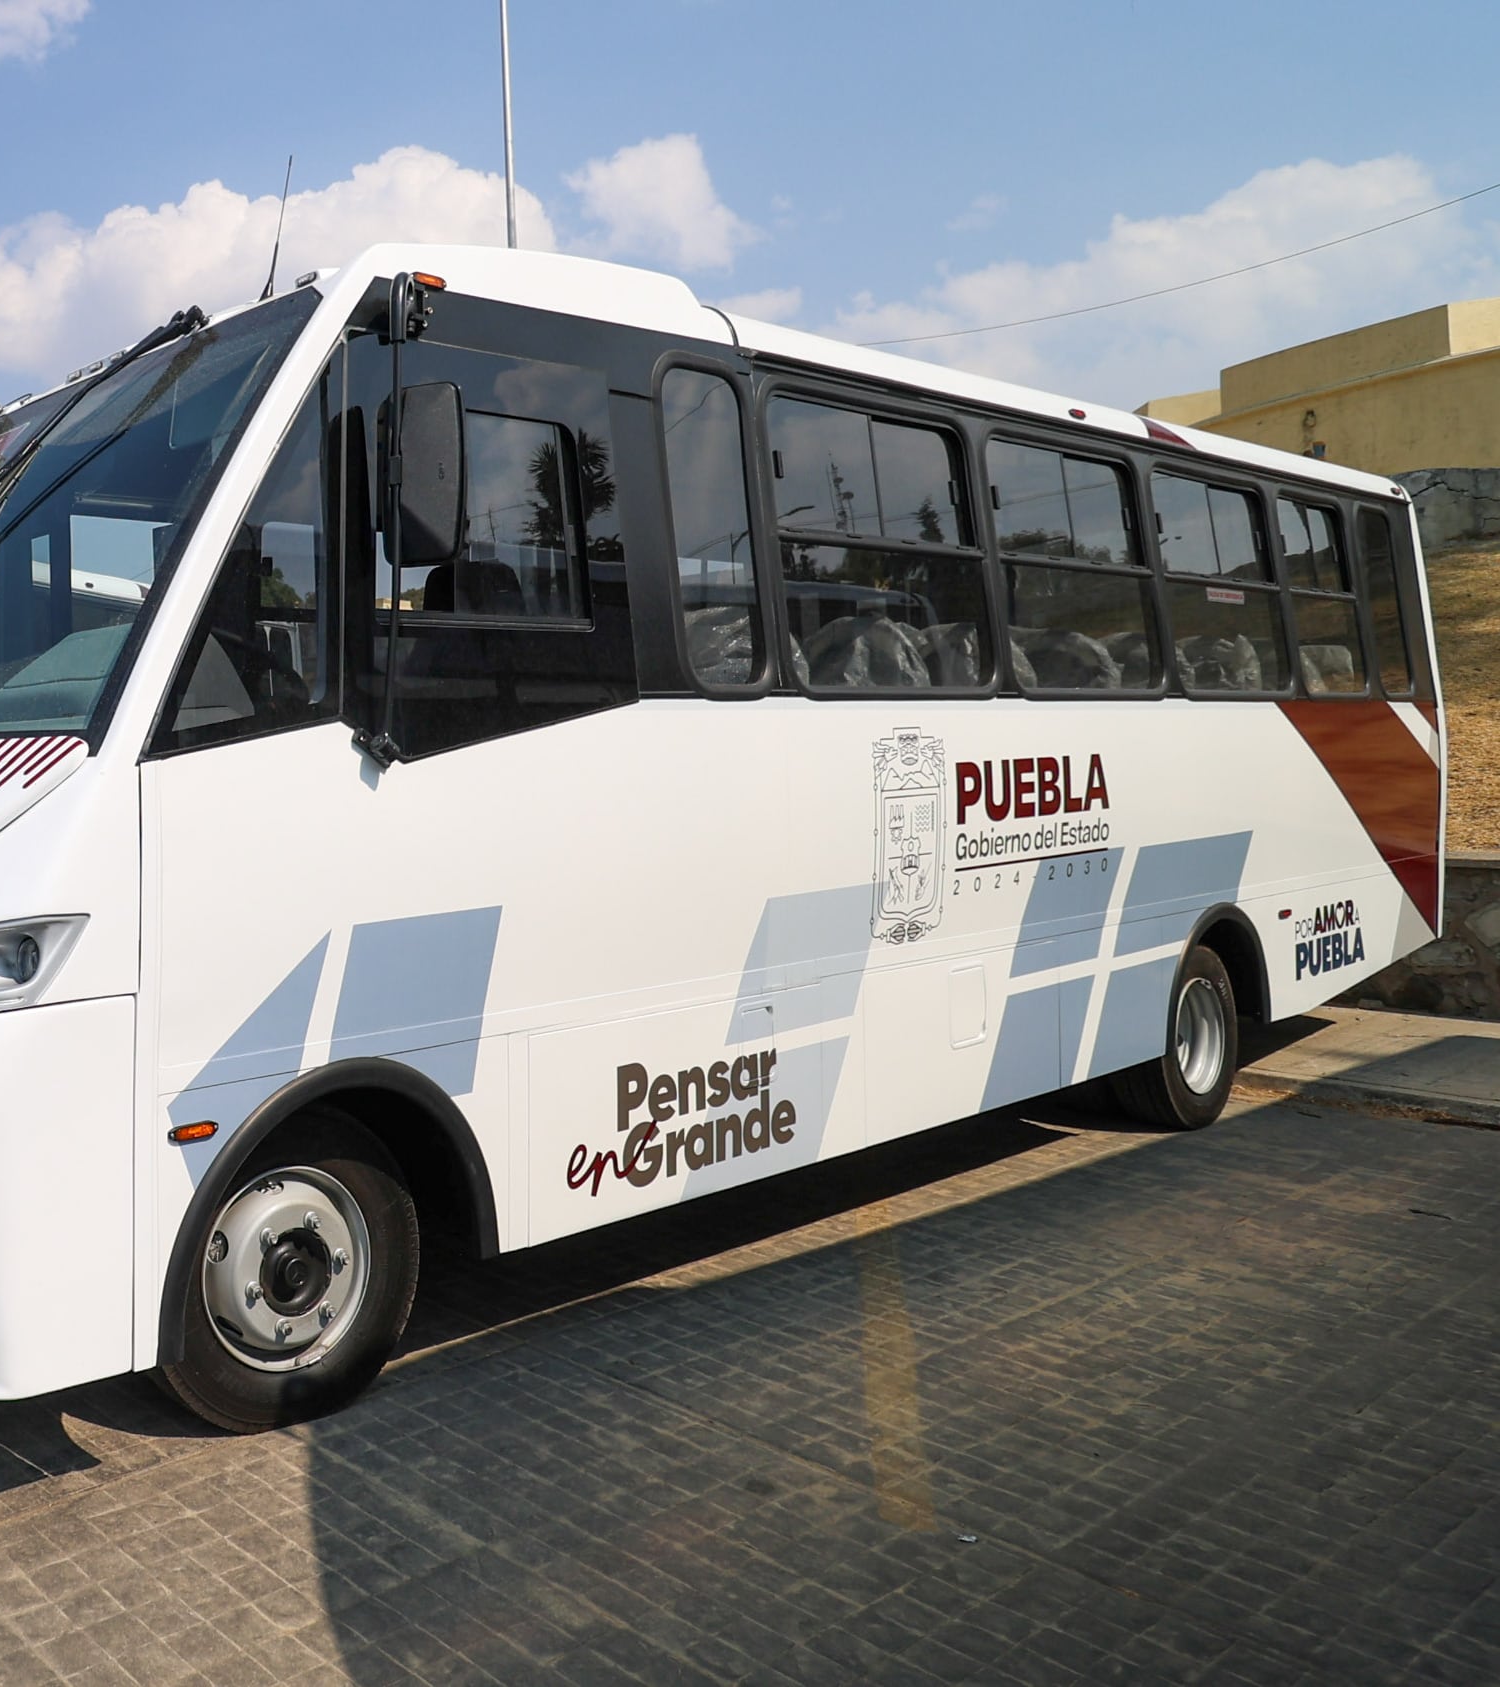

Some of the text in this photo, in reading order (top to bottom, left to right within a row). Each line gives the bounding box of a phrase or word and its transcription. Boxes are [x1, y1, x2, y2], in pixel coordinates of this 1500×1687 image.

[955, 753, 1110, 826] PUEBLA
[955, 817, 1110, 861] Gobierno del Estado
[1295, 917, 1314, 941] POR
[1313, 899, 1356, 936] AMOR
[1295, 926, 1366, 982] PUEBLA
[616, 1047, 777, 1133] Pensar
[566, 1119, 658, 1198] en
[623, 1088, 797, 1188] Grande
